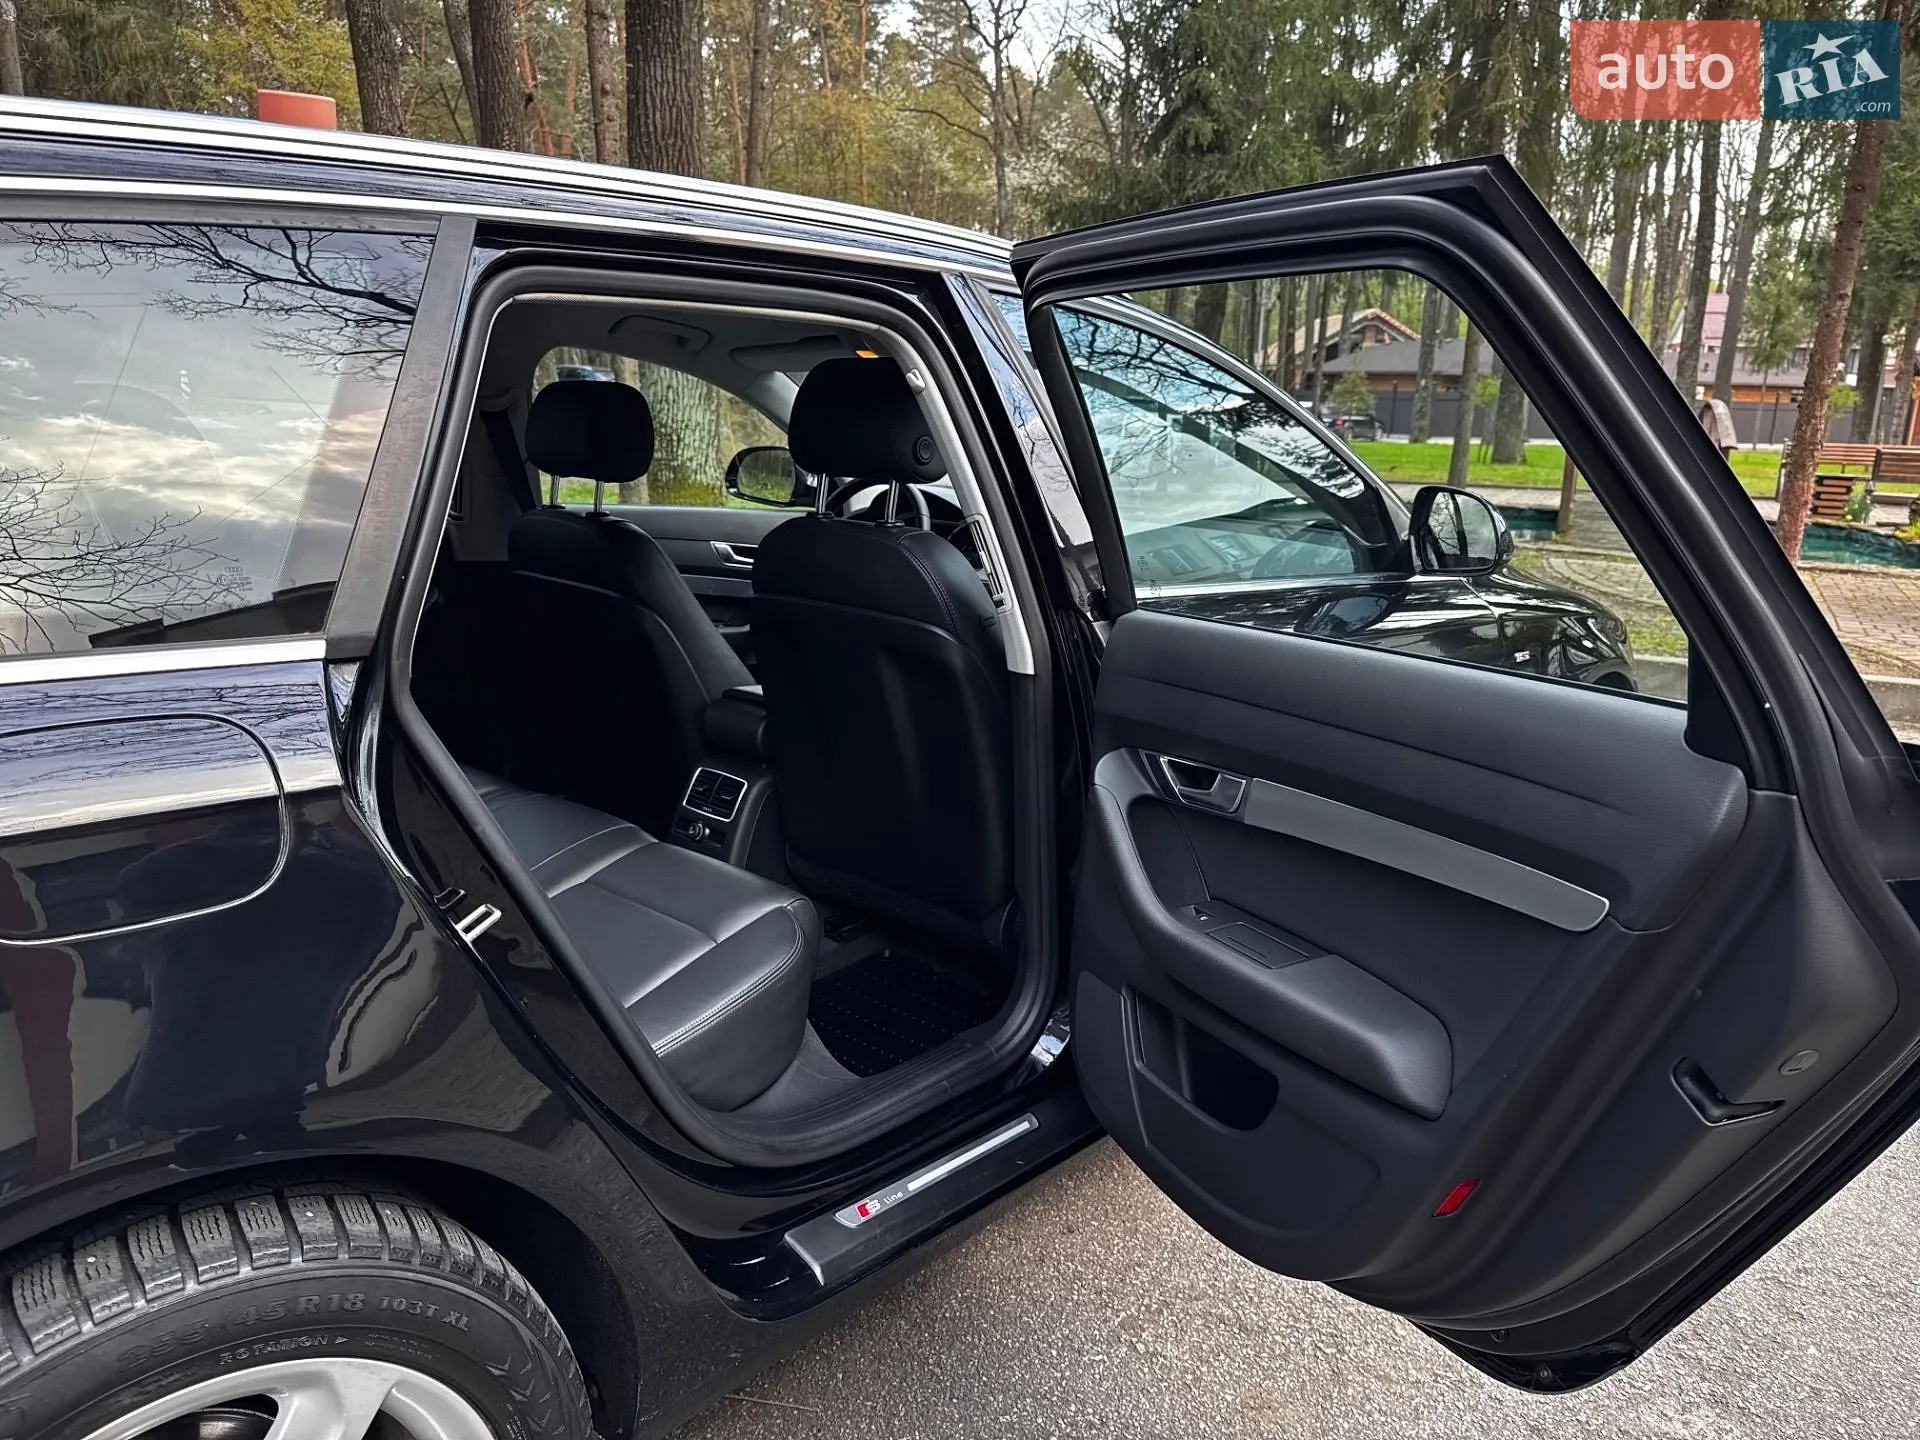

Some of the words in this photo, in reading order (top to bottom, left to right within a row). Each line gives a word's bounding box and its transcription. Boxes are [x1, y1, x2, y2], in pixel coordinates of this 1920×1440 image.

[883, 1191, 904, 1204] line
[378, 1295, 440, 1319] 103T
[440, 1309, 470, 1332] XL
[218, 1333, 331, 1366] ROTATION
